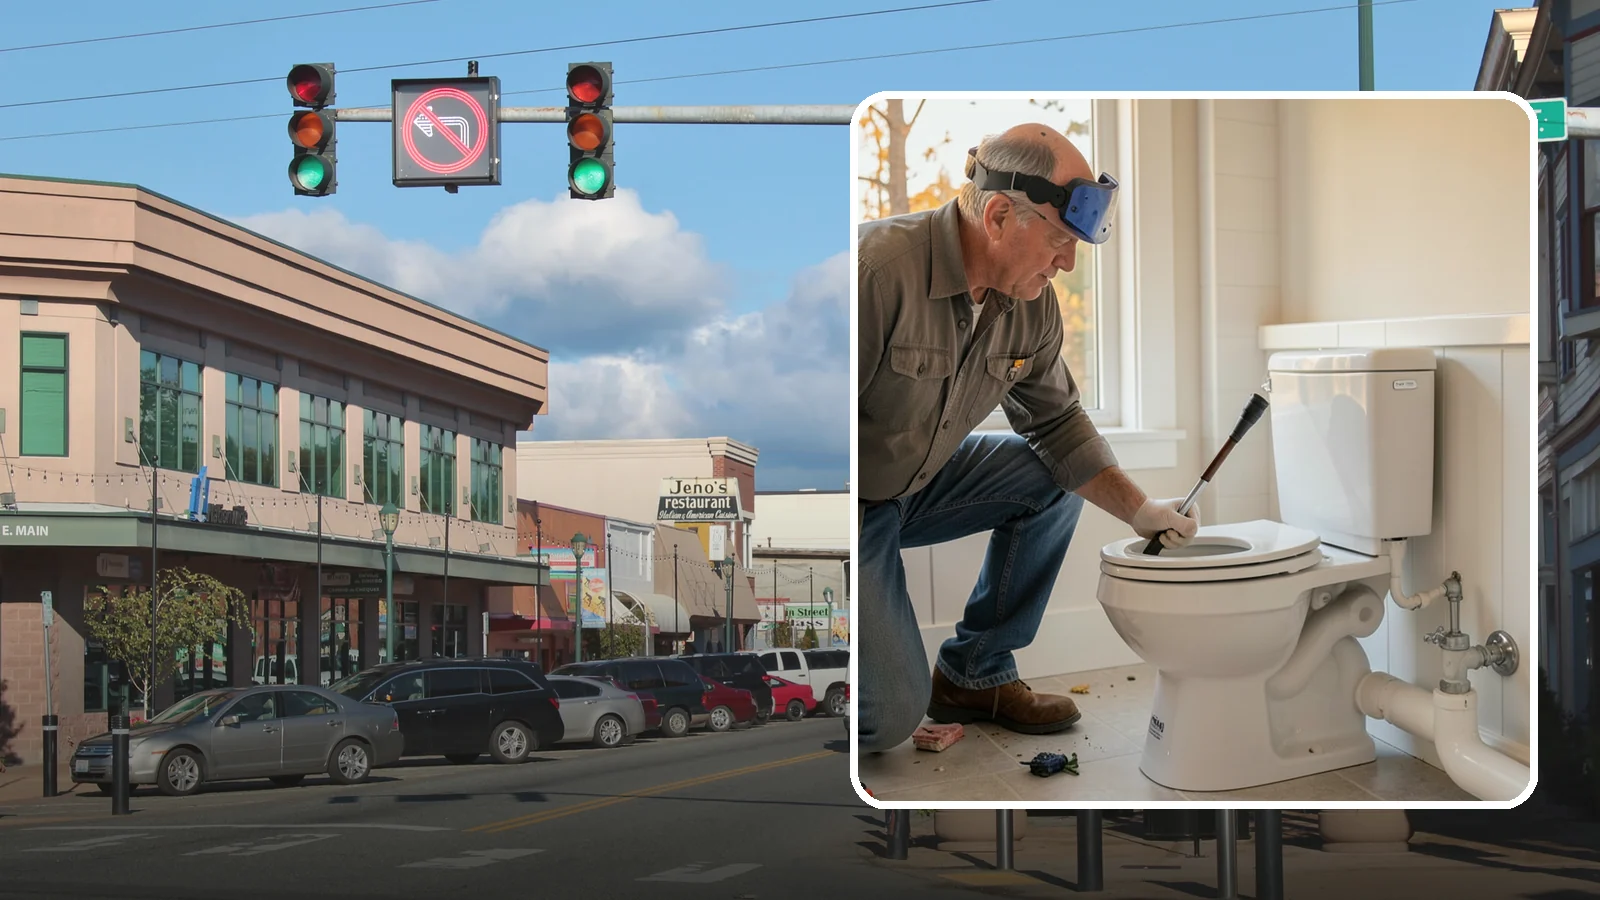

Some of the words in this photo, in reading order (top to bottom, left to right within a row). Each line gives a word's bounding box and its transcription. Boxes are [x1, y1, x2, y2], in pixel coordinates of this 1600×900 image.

[670, 480, 728, 495] Jeno's
[665, 496, 731, 509] restaurant
[659, 509, 681, 519] Italian
[686, 509, 714, 519] American
[715, 509, 738, 519] Cuisine
[2, 525, 13, 536] E.
[15, 525, 49, 536] MAIN
[797, 608, 829, 616] Street
